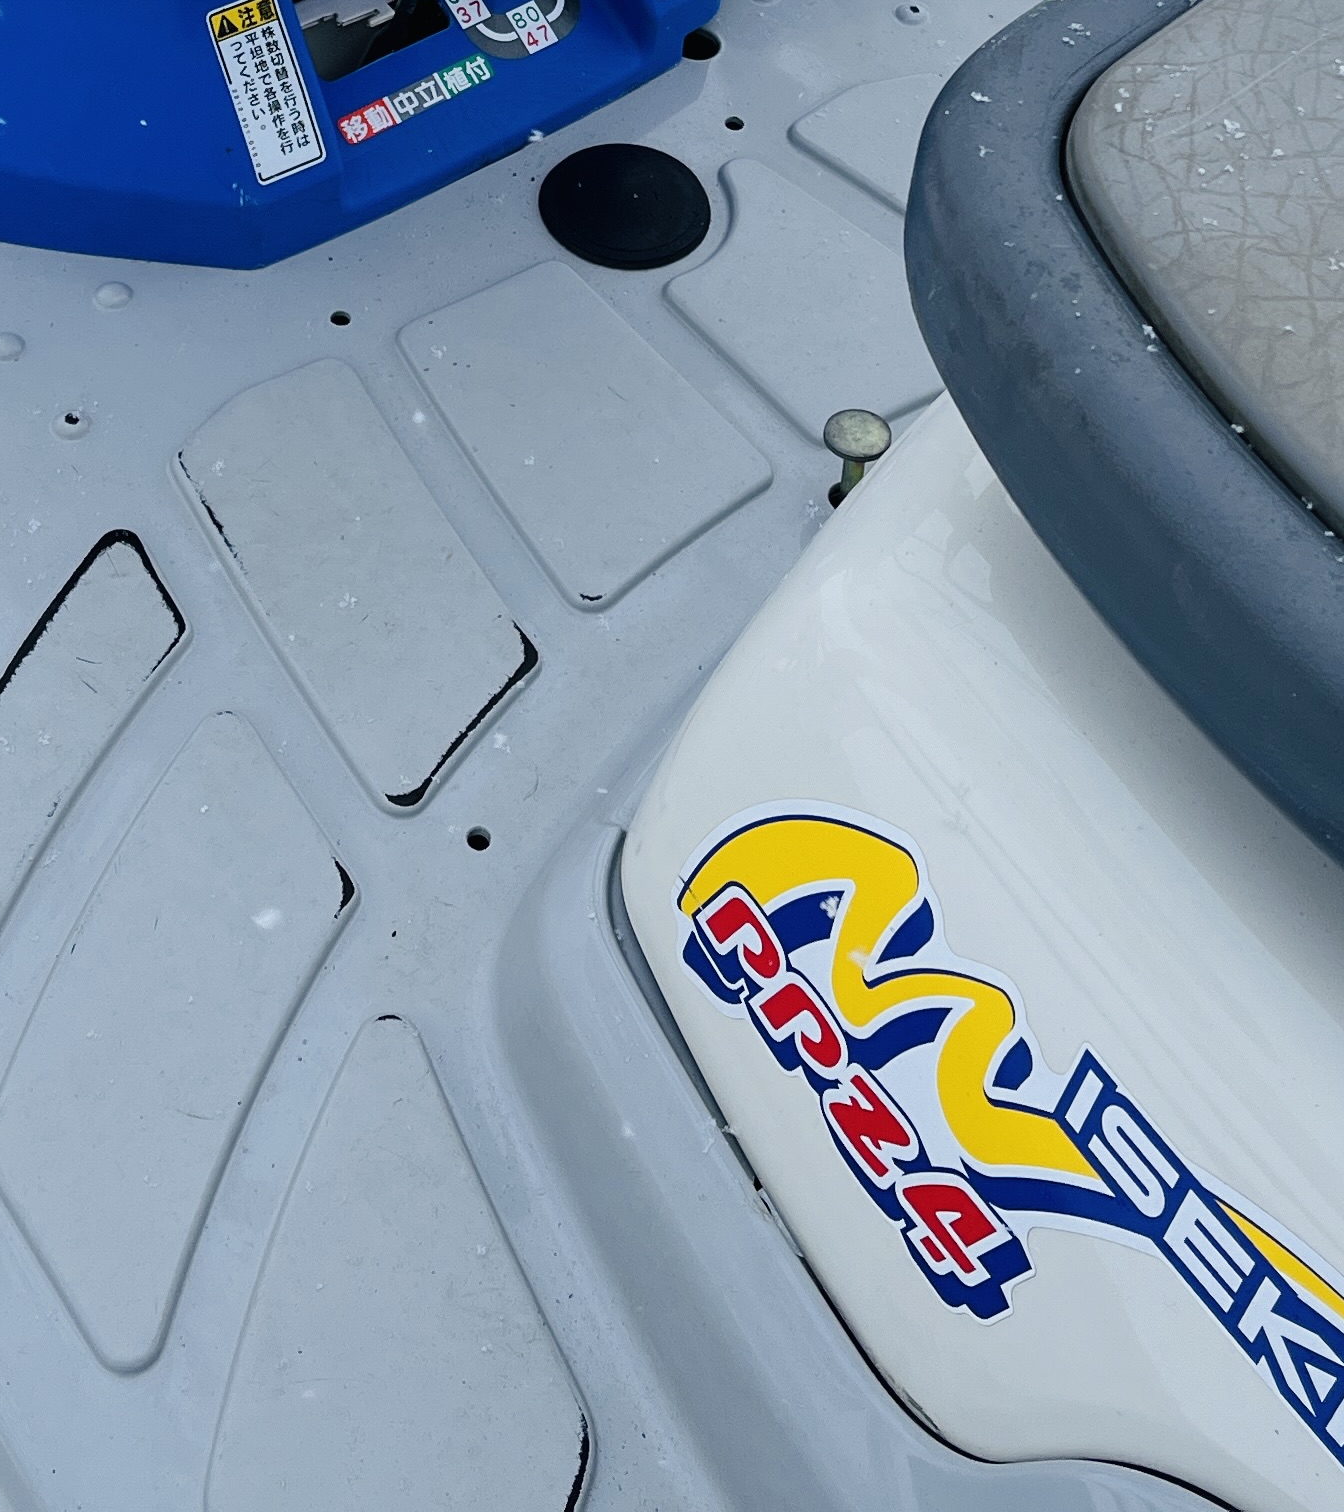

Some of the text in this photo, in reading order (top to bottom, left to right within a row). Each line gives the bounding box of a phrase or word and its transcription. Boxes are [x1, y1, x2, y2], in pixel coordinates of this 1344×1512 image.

[457, 0, 482, 23] 37
[512, 6, 540, 29] 80
[527, 24, 549, 47] 47
[230, 41, 267, 131] ってください。
[245, 32, 294, 156] 平坦地で各操作を行
[261, 26, 311, 148] 株数切替を行う時は
[340, 55, 491, 144] 移動 中立 植付
